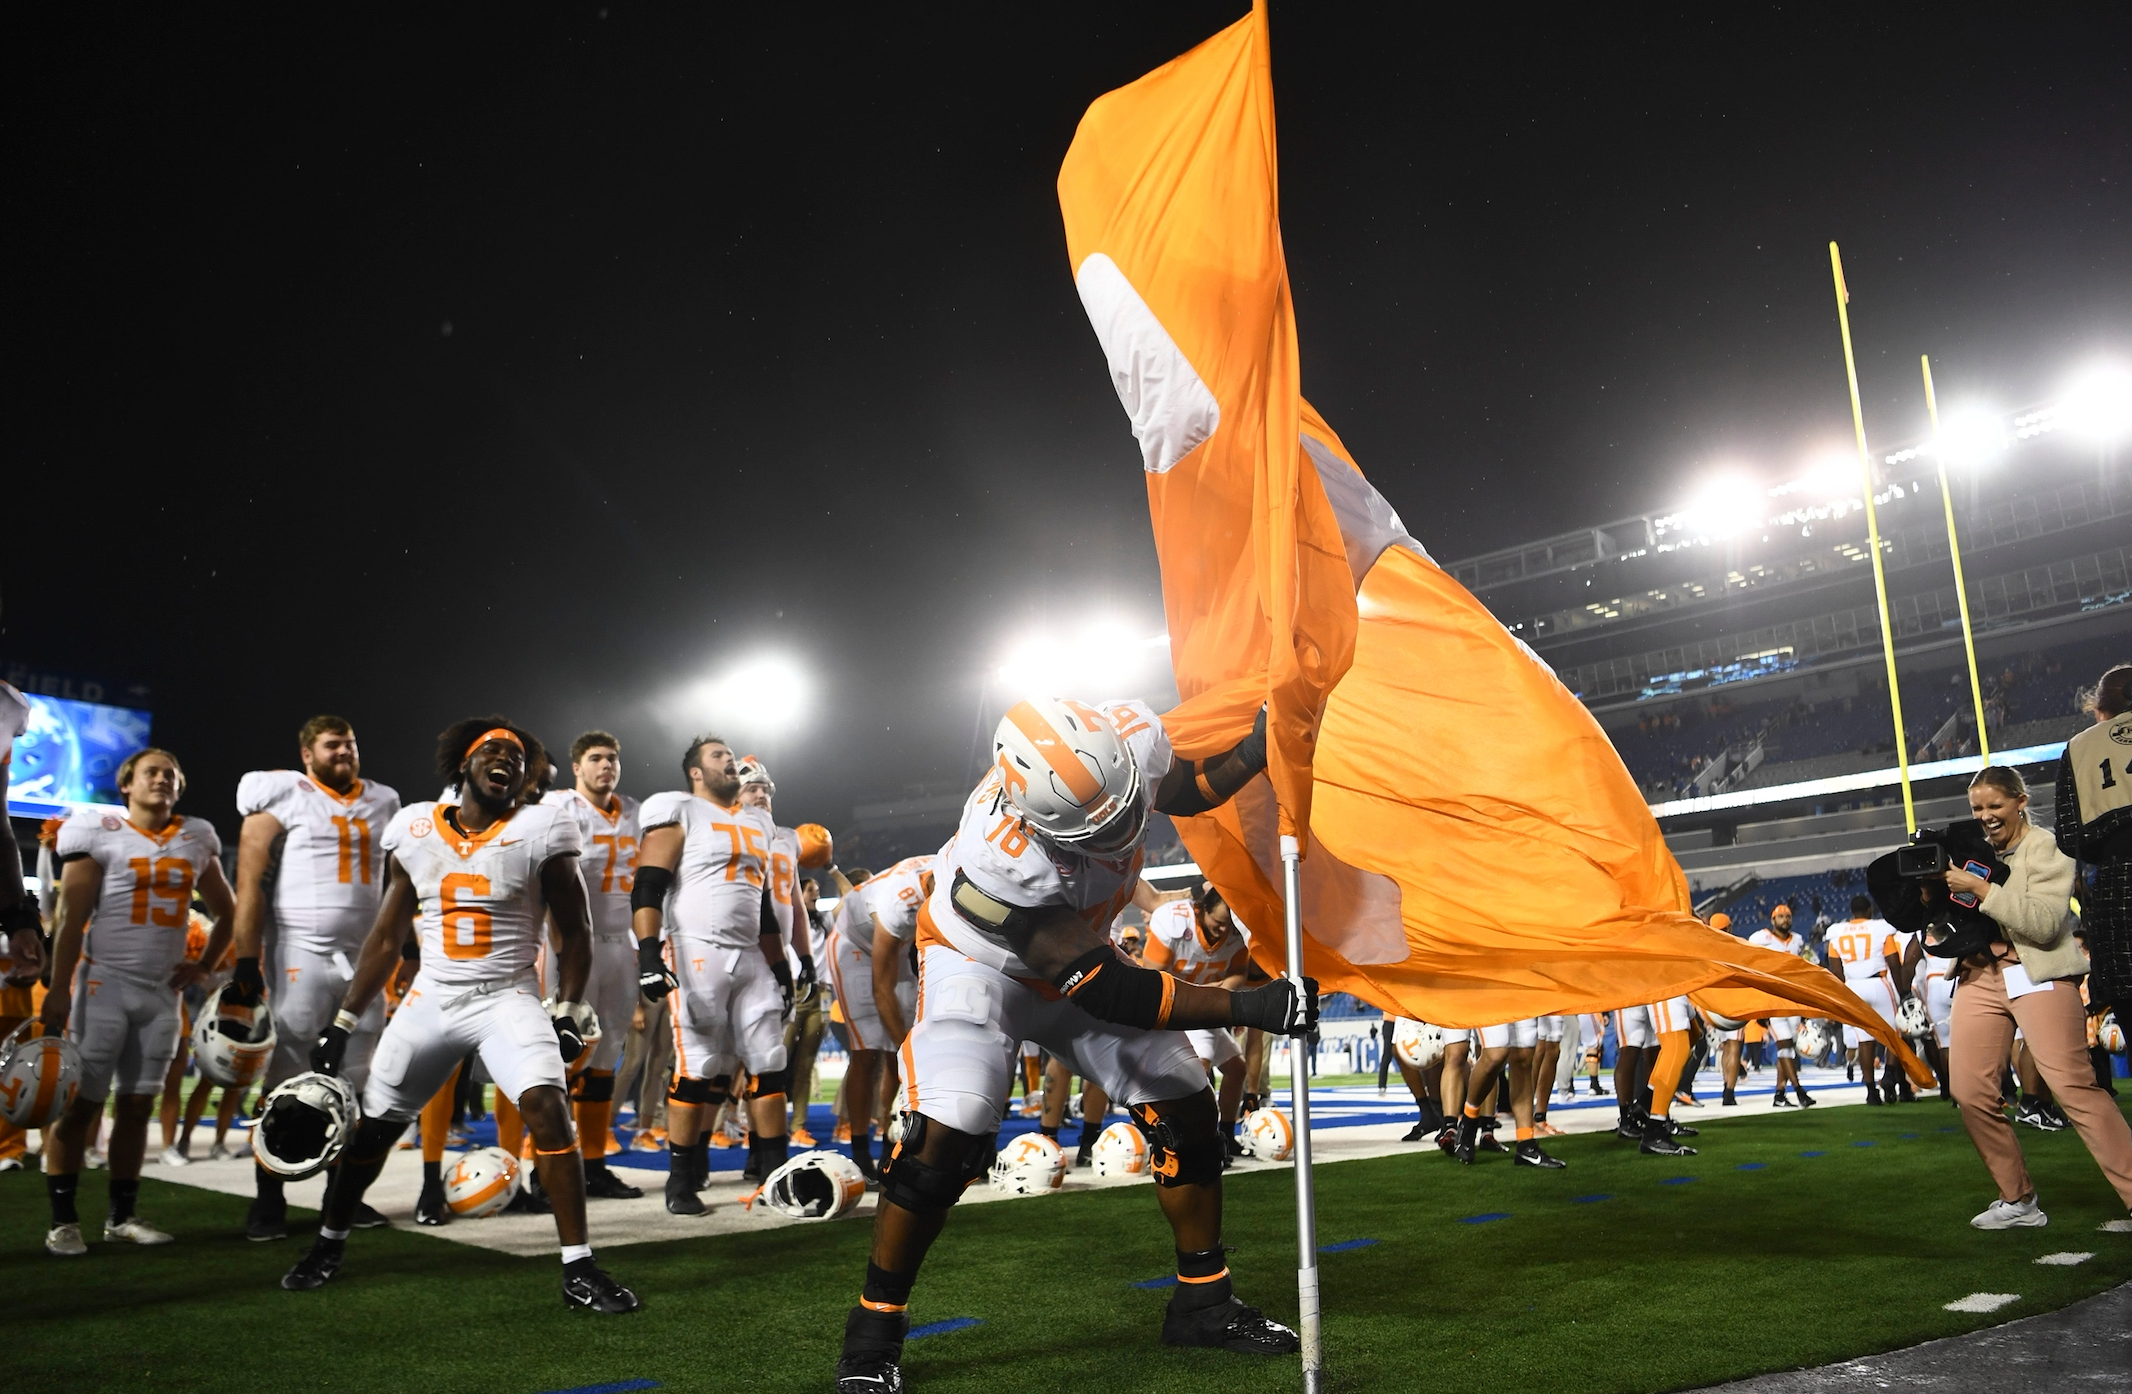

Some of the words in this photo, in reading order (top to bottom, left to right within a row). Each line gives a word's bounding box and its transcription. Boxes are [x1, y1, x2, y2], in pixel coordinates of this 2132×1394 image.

[411, 820, 432, 837] SEC
[331, 815, 371, 885] 11
[458, 842, 473, 855] T
[711, 822, 769, 887] 75
[593, 834, 640, 893] 73
[129, 856, 194, 928] 19
[440, 872, 492, 960] 6
[1838, 933, 1871, 963] 97
[286, 967, 302, 983] T
[87, 980, 102, 996] T
[405, 989, 422, 1007] T
[940, 977, 987, 1015] T
[1254, 1116, 1274, 1138] T
[1017, 1140, 1041, 1162] T
[1099, 1129, 1117, 1151] T
